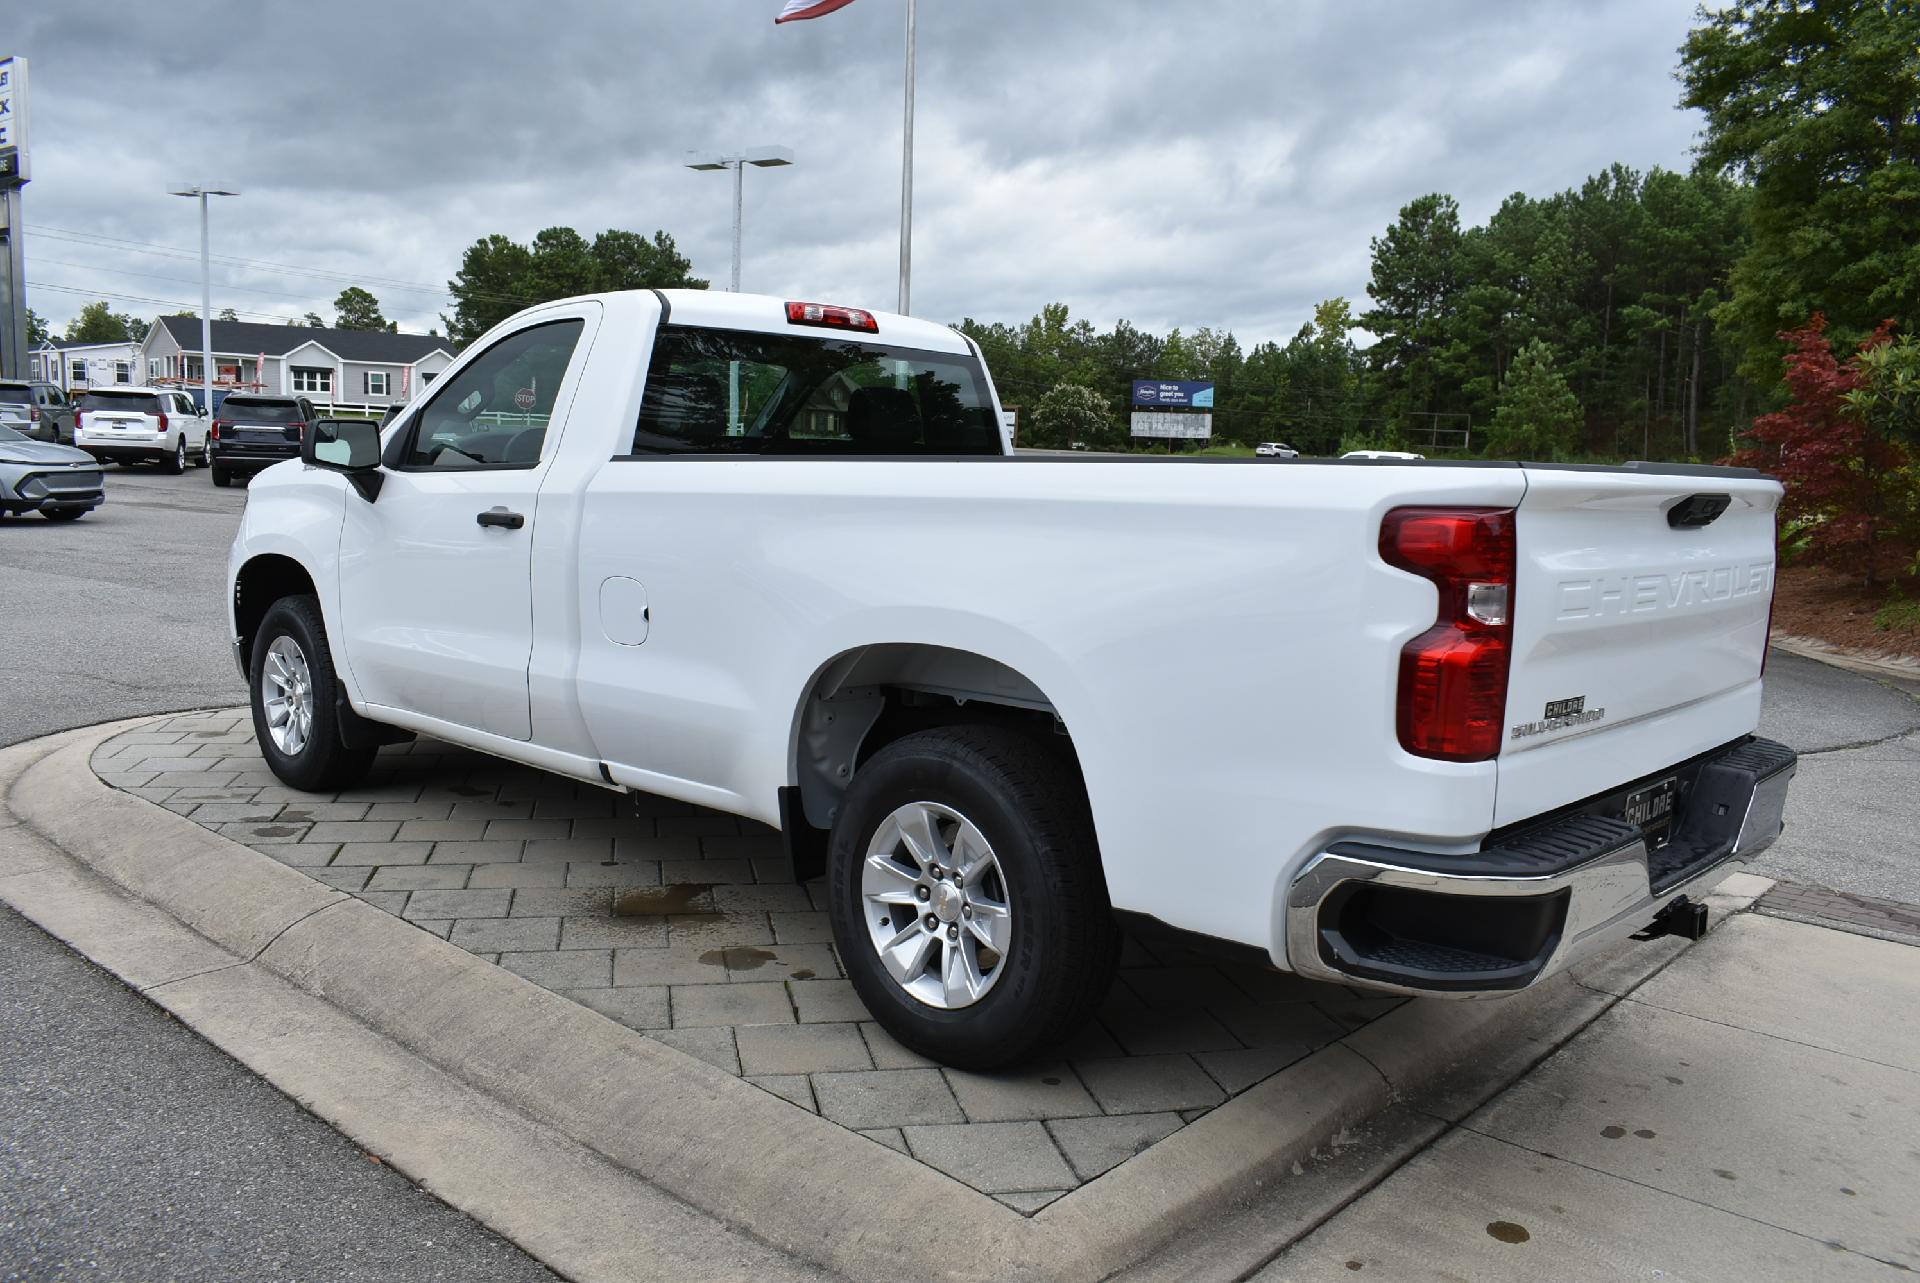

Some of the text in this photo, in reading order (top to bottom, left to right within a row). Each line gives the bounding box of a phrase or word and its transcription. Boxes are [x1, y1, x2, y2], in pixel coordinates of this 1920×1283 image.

[517, 394, 535, 402] STOP
[1558, 562, 1773, 620] CHEVROLET
[1546, 697, 1584, 716] CHILDRE
[1627, 791, 1673, 825] CHILDRE
